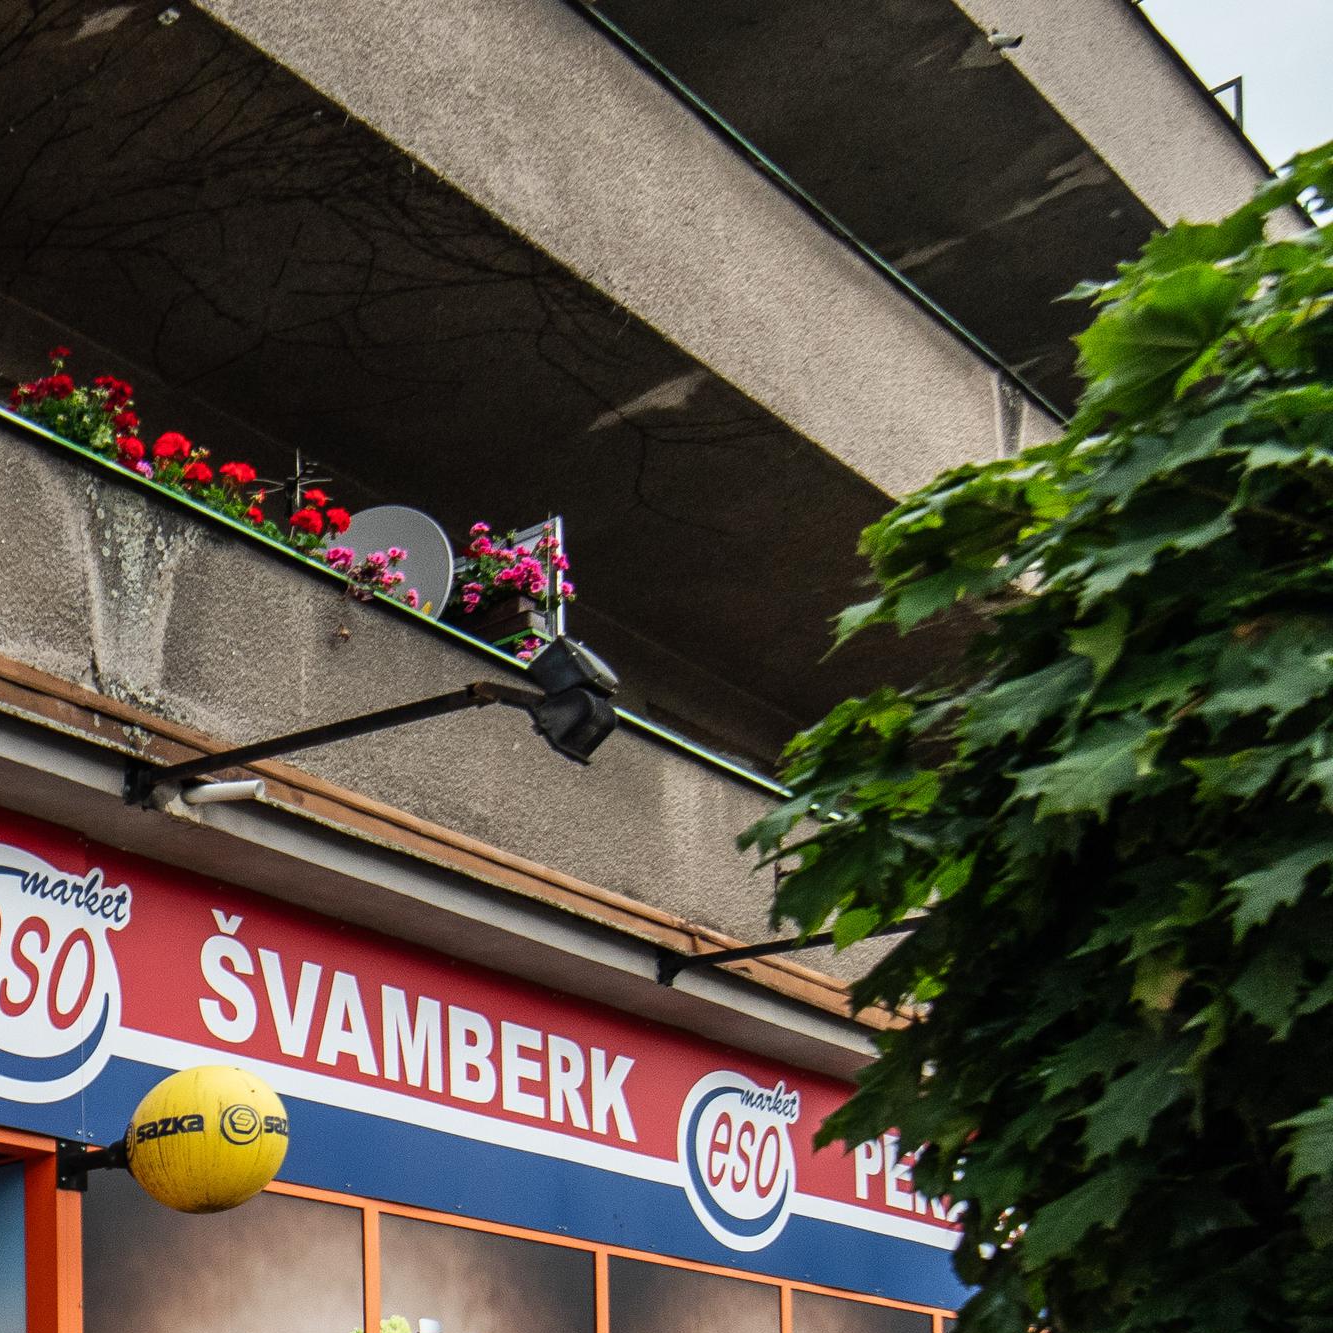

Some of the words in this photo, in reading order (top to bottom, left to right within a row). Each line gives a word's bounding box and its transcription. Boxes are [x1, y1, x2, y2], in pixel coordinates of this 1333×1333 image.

[21, 870, 127, 922] market
[199, 909, 637, 1142] ŠVAMBERK
[741, 1080, 797, 1118] market
[708, 1112, 780, 1198] eso
